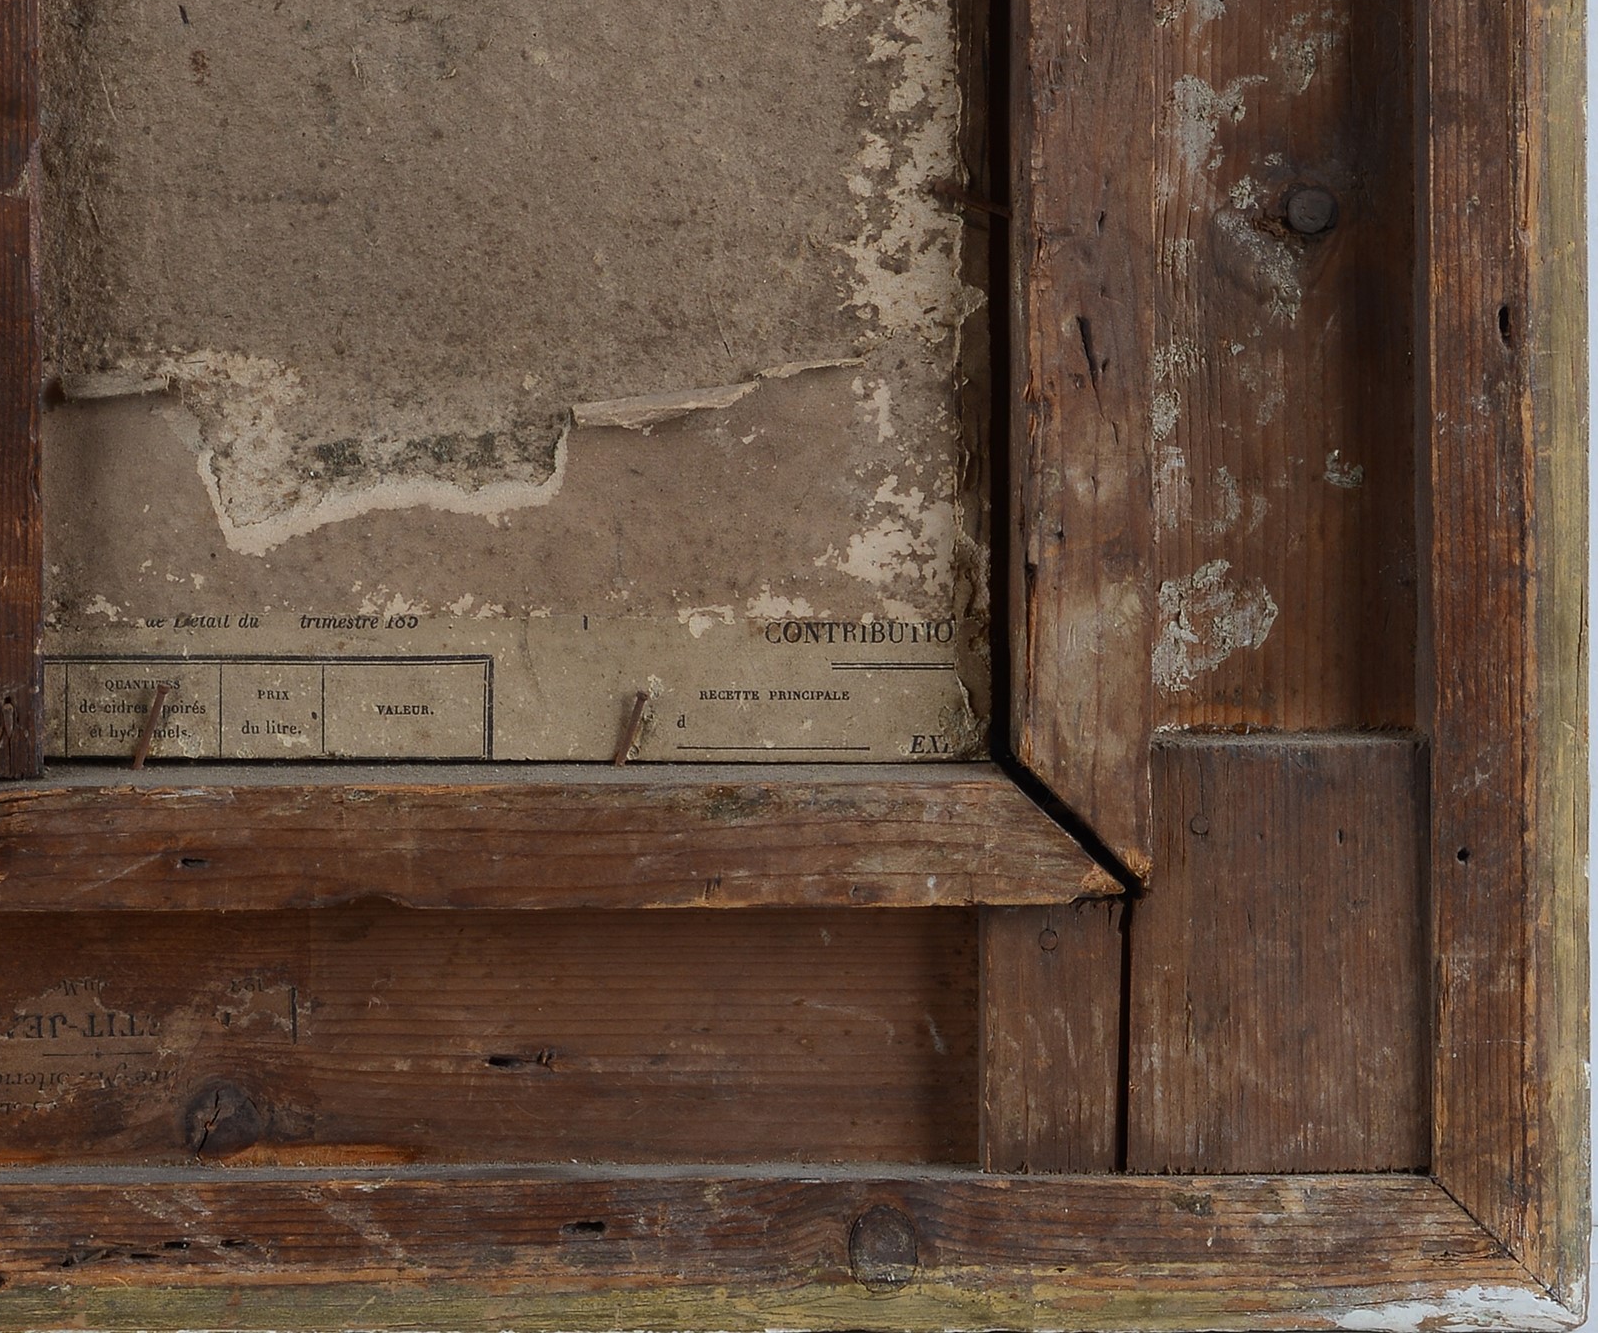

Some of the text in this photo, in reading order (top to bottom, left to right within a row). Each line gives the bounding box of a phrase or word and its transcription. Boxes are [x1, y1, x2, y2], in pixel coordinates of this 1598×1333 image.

[238, 615, 260, 629] du
[300, 614, 379, 629] trimestre
[257, 689, 290, 700] PRIX
[699, 689, 850, 701] RECETTE PRINCIPALE
[79, 698, 206, 719] de cidres poirés
[376, 704, 435, 716] VALEUR.
[241, 720, 302, 735] du litre.
[676, 714, 687, 729] d
